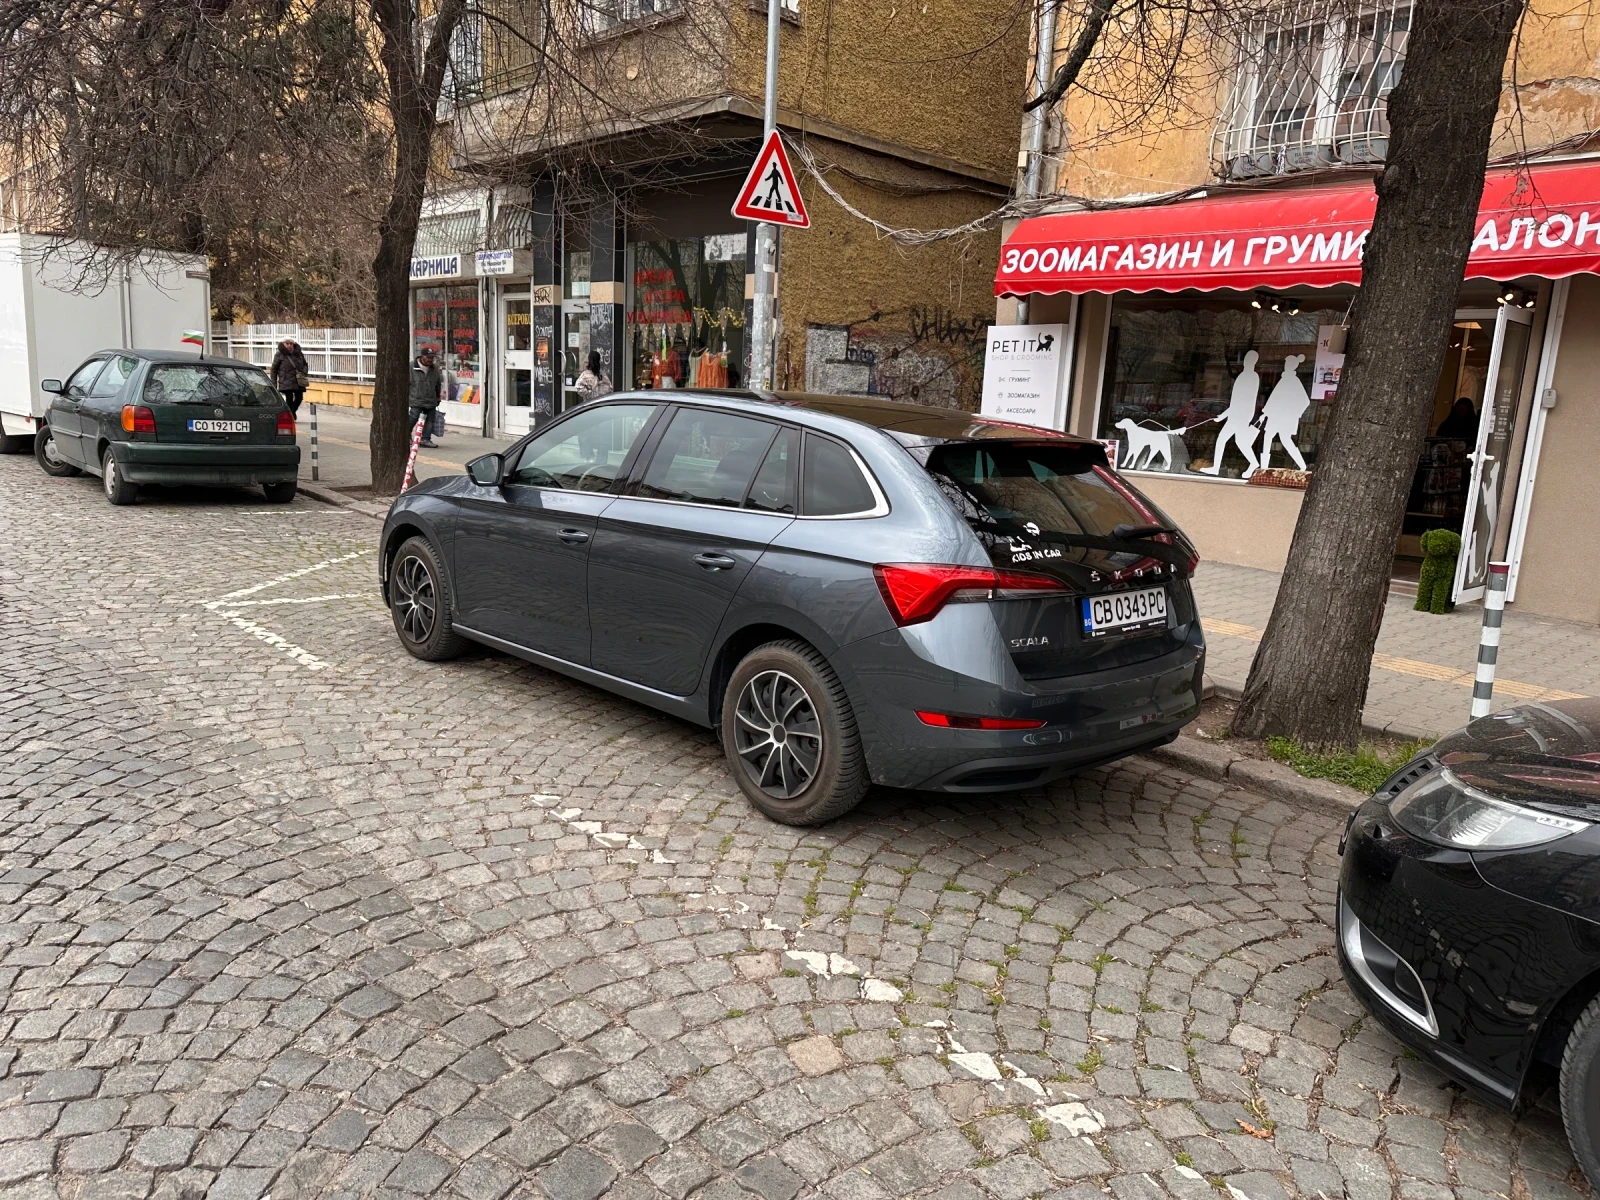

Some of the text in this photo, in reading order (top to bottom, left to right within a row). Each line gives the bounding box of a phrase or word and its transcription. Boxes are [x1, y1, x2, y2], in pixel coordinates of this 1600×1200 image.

[1002, 211, 1600, 274] ЗООМАГАЗИН И ГРУМИ АЛОН
[194, 420, 248, 431] CO 1921 CH
[1034, 551, 1045, 560] IN
[1044, 549, 1062, 558] CAR
[1093, 590, 1165, 625] CB 0343 PC
[1010, 636, 1049, 648] SCALA
